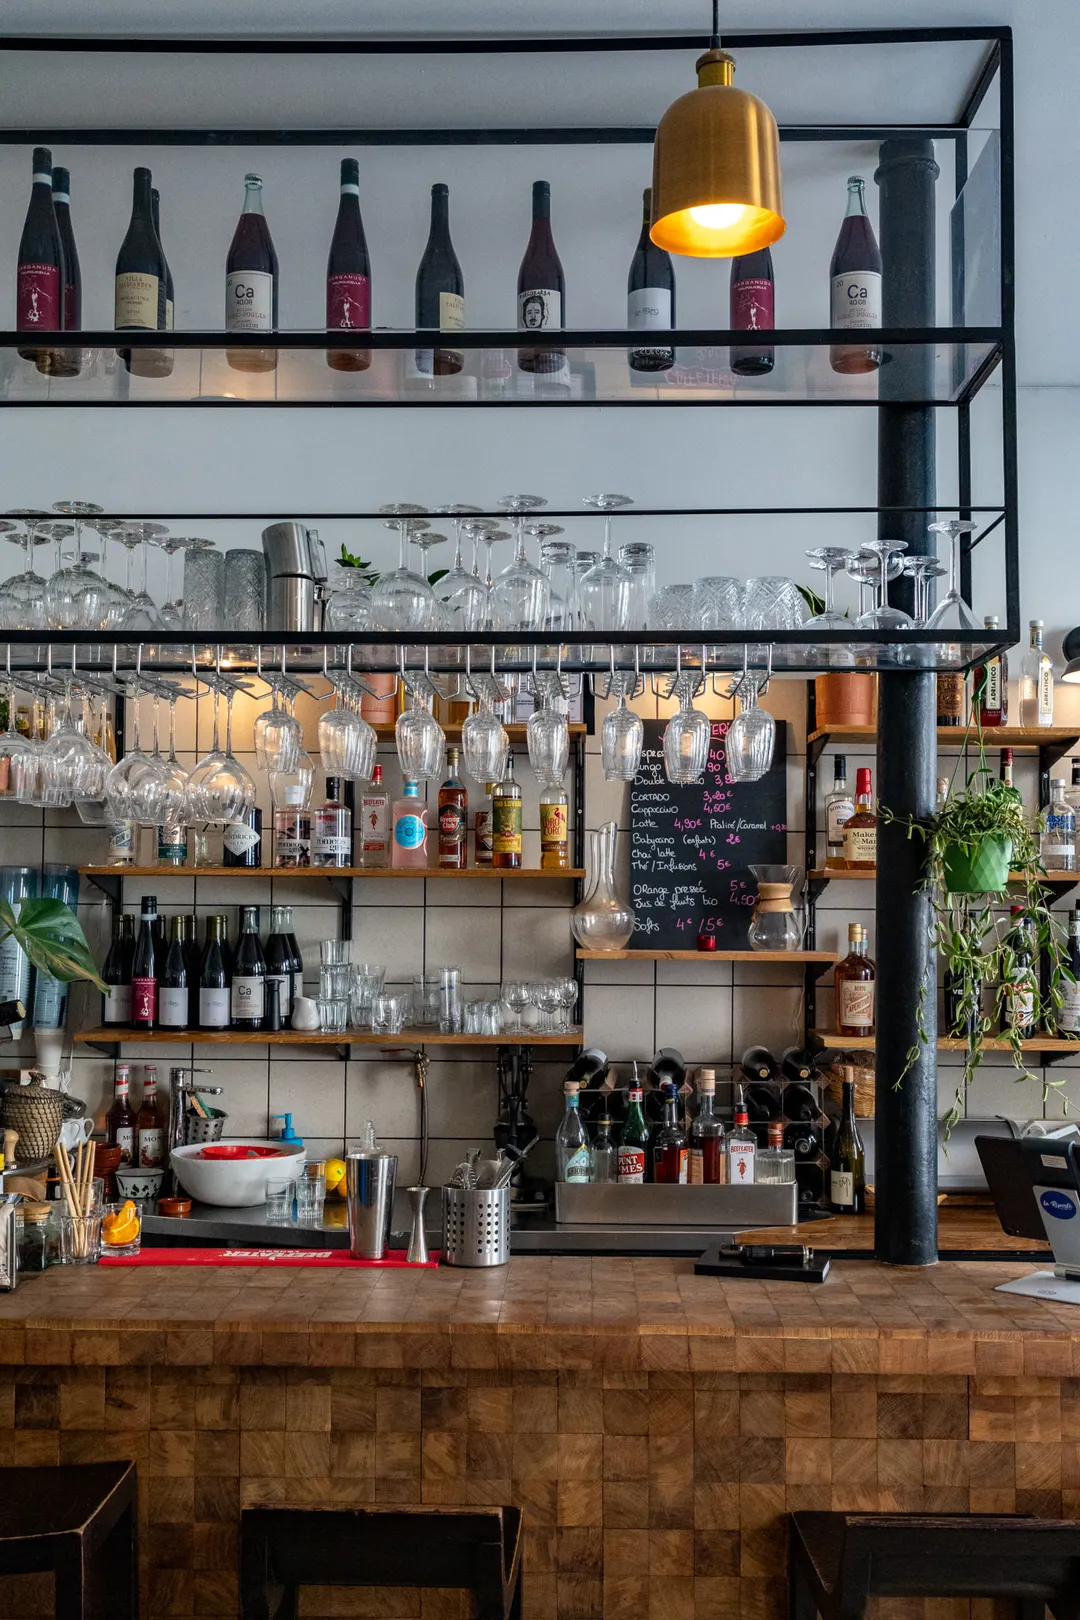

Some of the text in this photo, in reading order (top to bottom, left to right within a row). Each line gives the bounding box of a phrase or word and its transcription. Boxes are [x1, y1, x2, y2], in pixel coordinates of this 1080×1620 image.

[235, 283, 254, 298] Ca
[847, 284, 868, 298] Ca
[632, 818, 658, 828] Latte
[702, 894, 718, 906] bio
[238, 985, 252, 996] Ca
